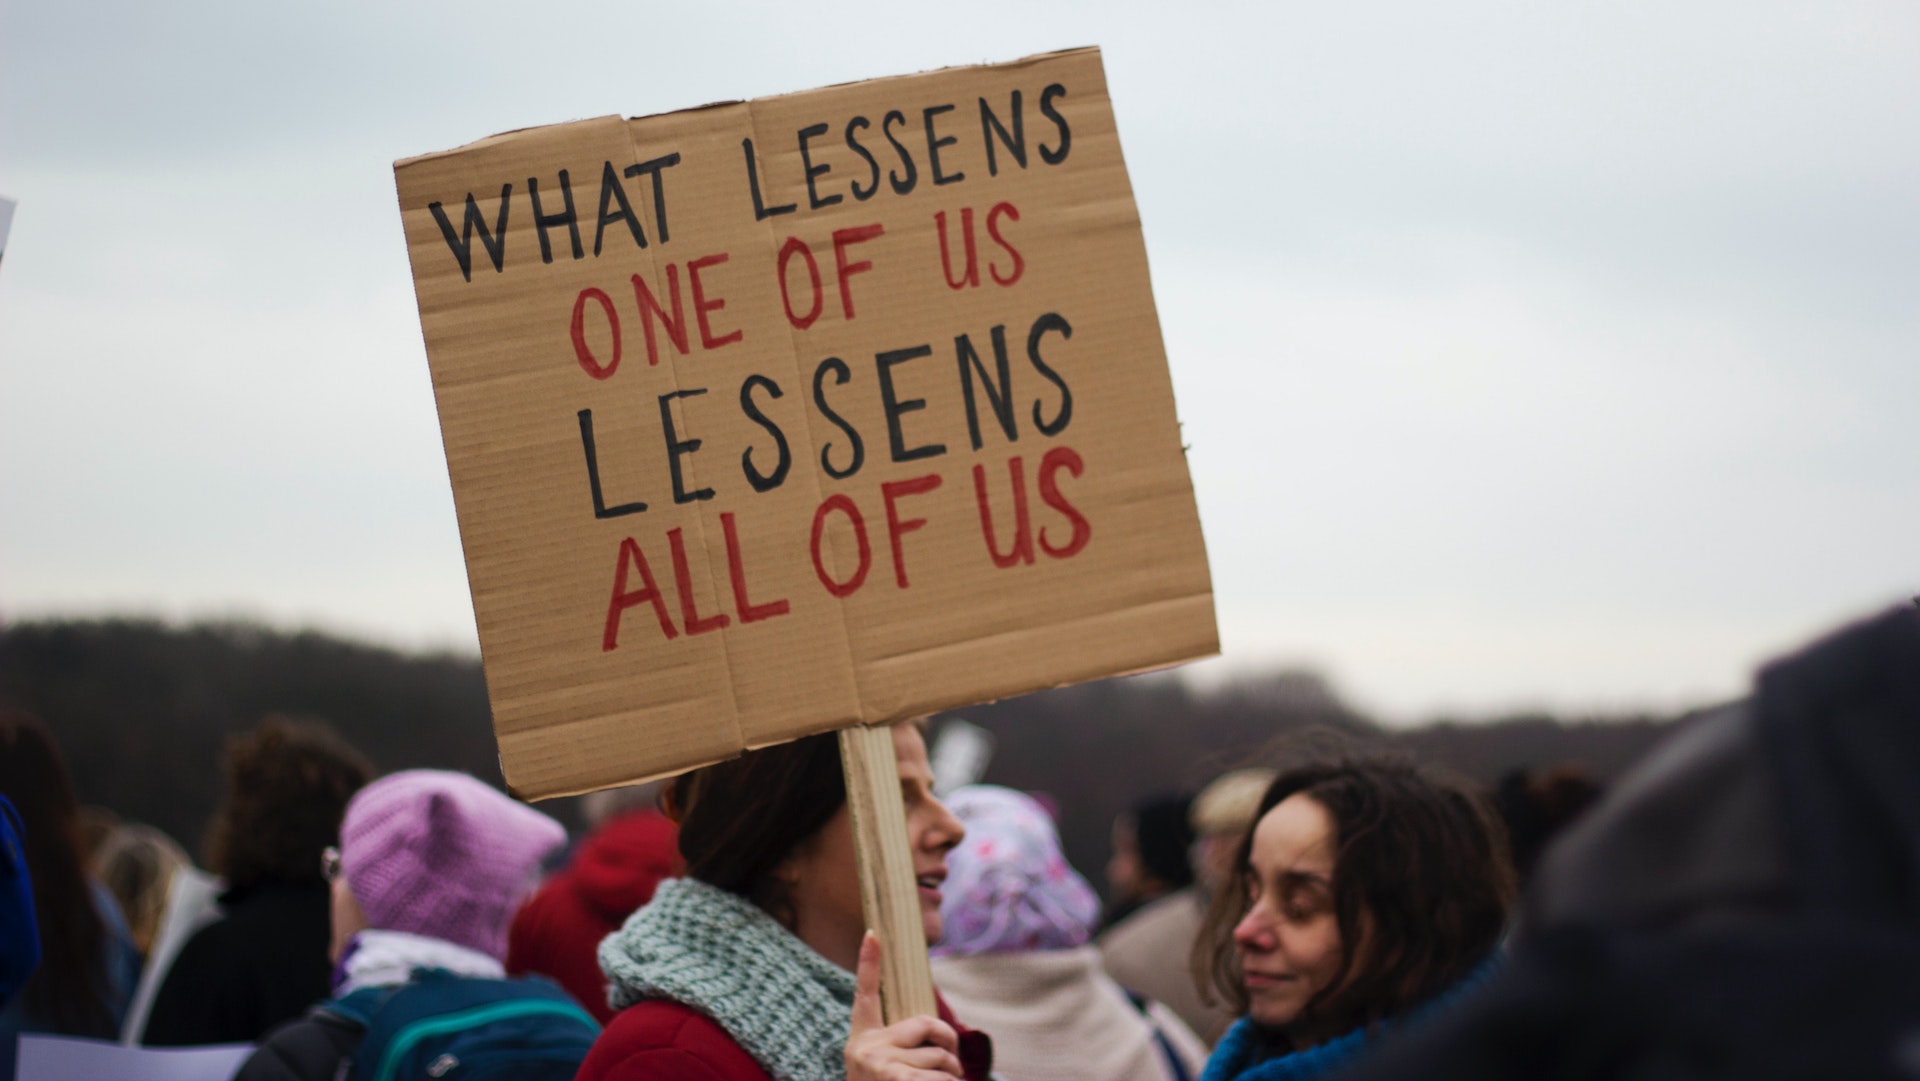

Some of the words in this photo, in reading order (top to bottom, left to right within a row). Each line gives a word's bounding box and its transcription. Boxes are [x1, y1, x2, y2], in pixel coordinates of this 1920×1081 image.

[428, 153, 680, 282] WHAT
[741, 83, 1072, 222] LESSENS
[570, 252, 743, 380] ONE
[776, 223, 885, 330] OF
[933, 201, 1025, 290] US
[576, 312, 1073, 519] LESSENS
[602, 511, 790, 652] ALL
[809, 474, 942, 599] OF
[972, 446, 1092, 569] US
